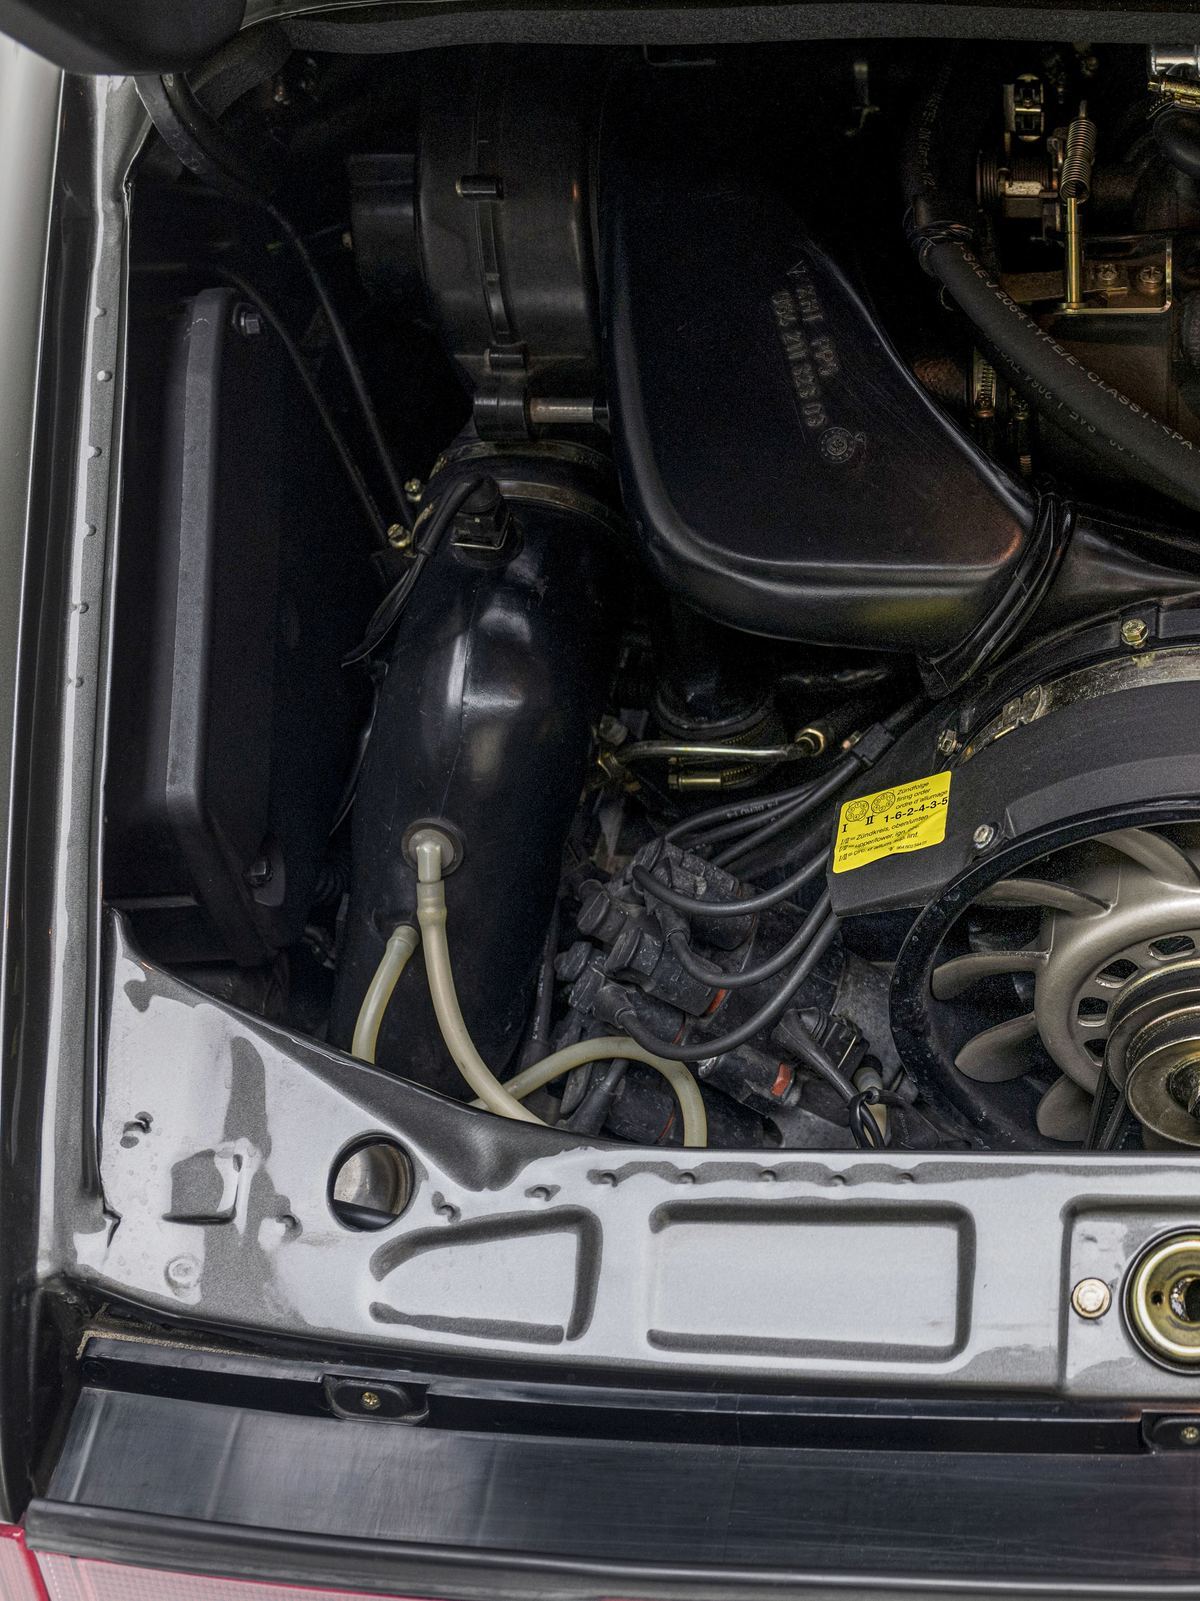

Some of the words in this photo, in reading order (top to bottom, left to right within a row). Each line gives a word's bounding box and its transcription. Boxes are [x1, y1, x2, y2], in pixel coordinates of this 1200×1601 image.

[995, 291, 1027, 320] 2064
[1087, 372, 1141, 413] CLASS
[914, 788, 931, 797] order
[884, 797, 948, 823] 1-6-2-4-3-5
